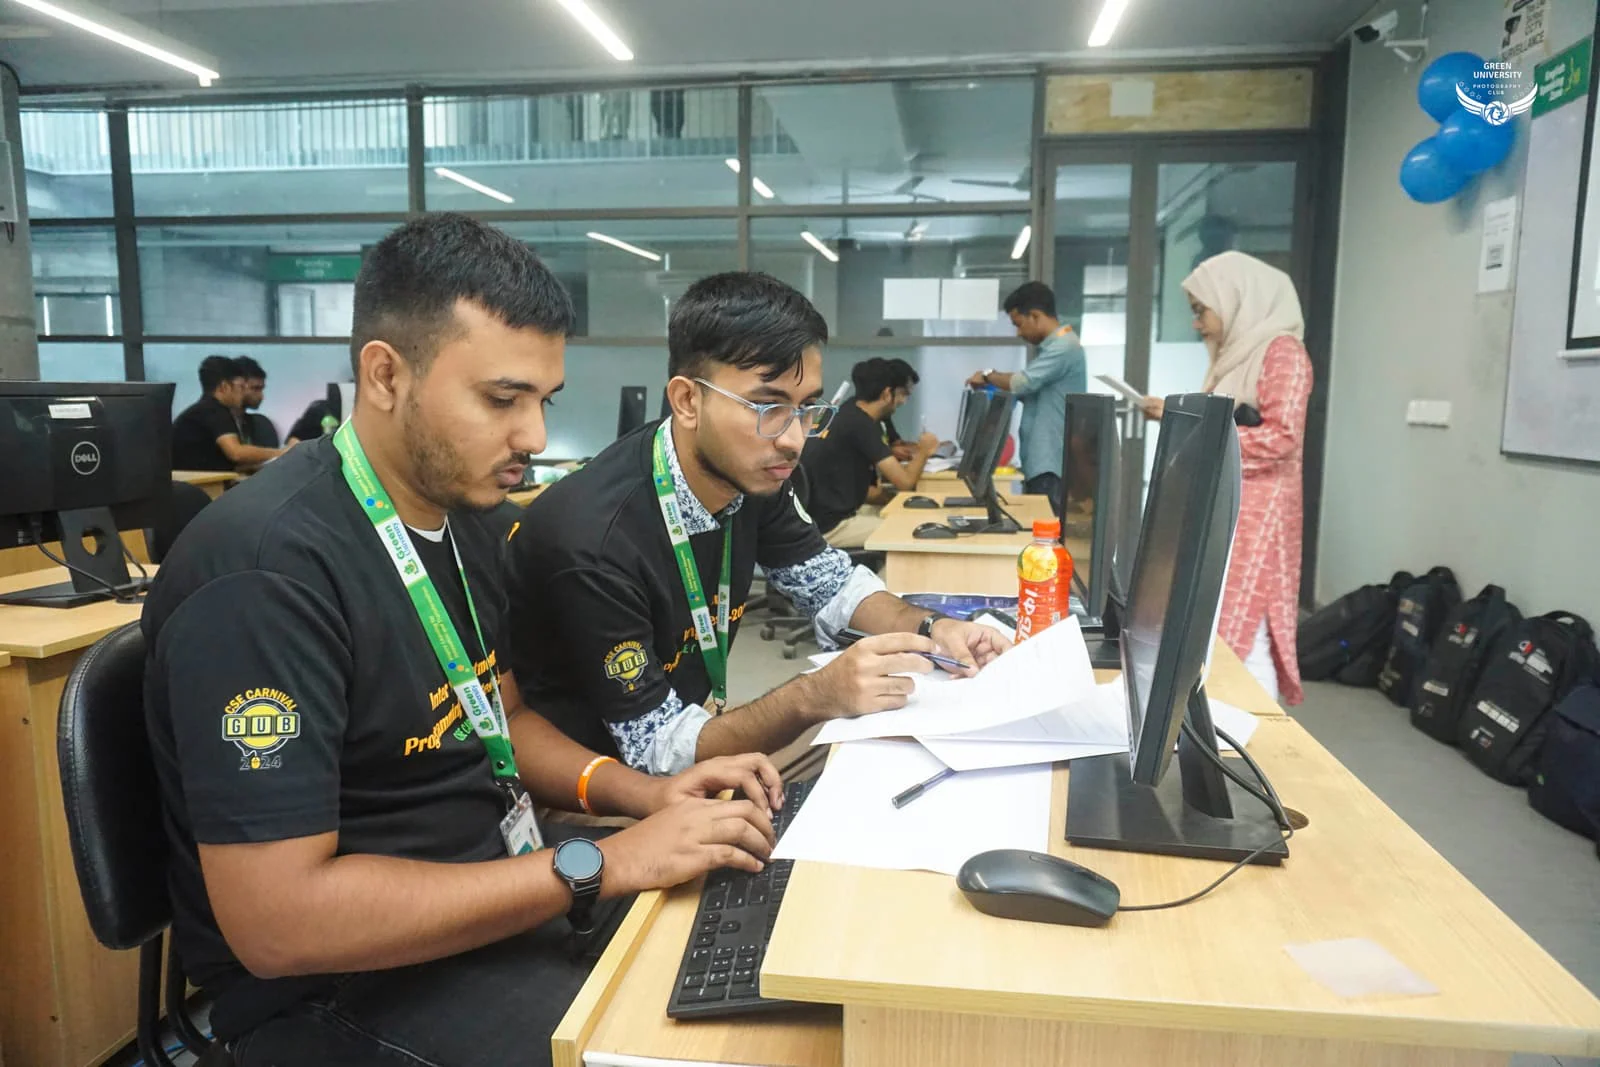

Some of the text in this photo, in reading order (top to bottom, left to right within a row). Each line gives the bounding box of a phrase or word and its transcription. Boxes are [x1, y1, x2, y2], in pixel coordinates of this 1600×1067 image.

[75, 453, 97, 463] DELL
[385, 525, 406, 560] Green
[224, 687, 297, 714] CSE CARNIVAL
[429, 683, 449, 711] Inter
[463, 686, 482, 717] Green
